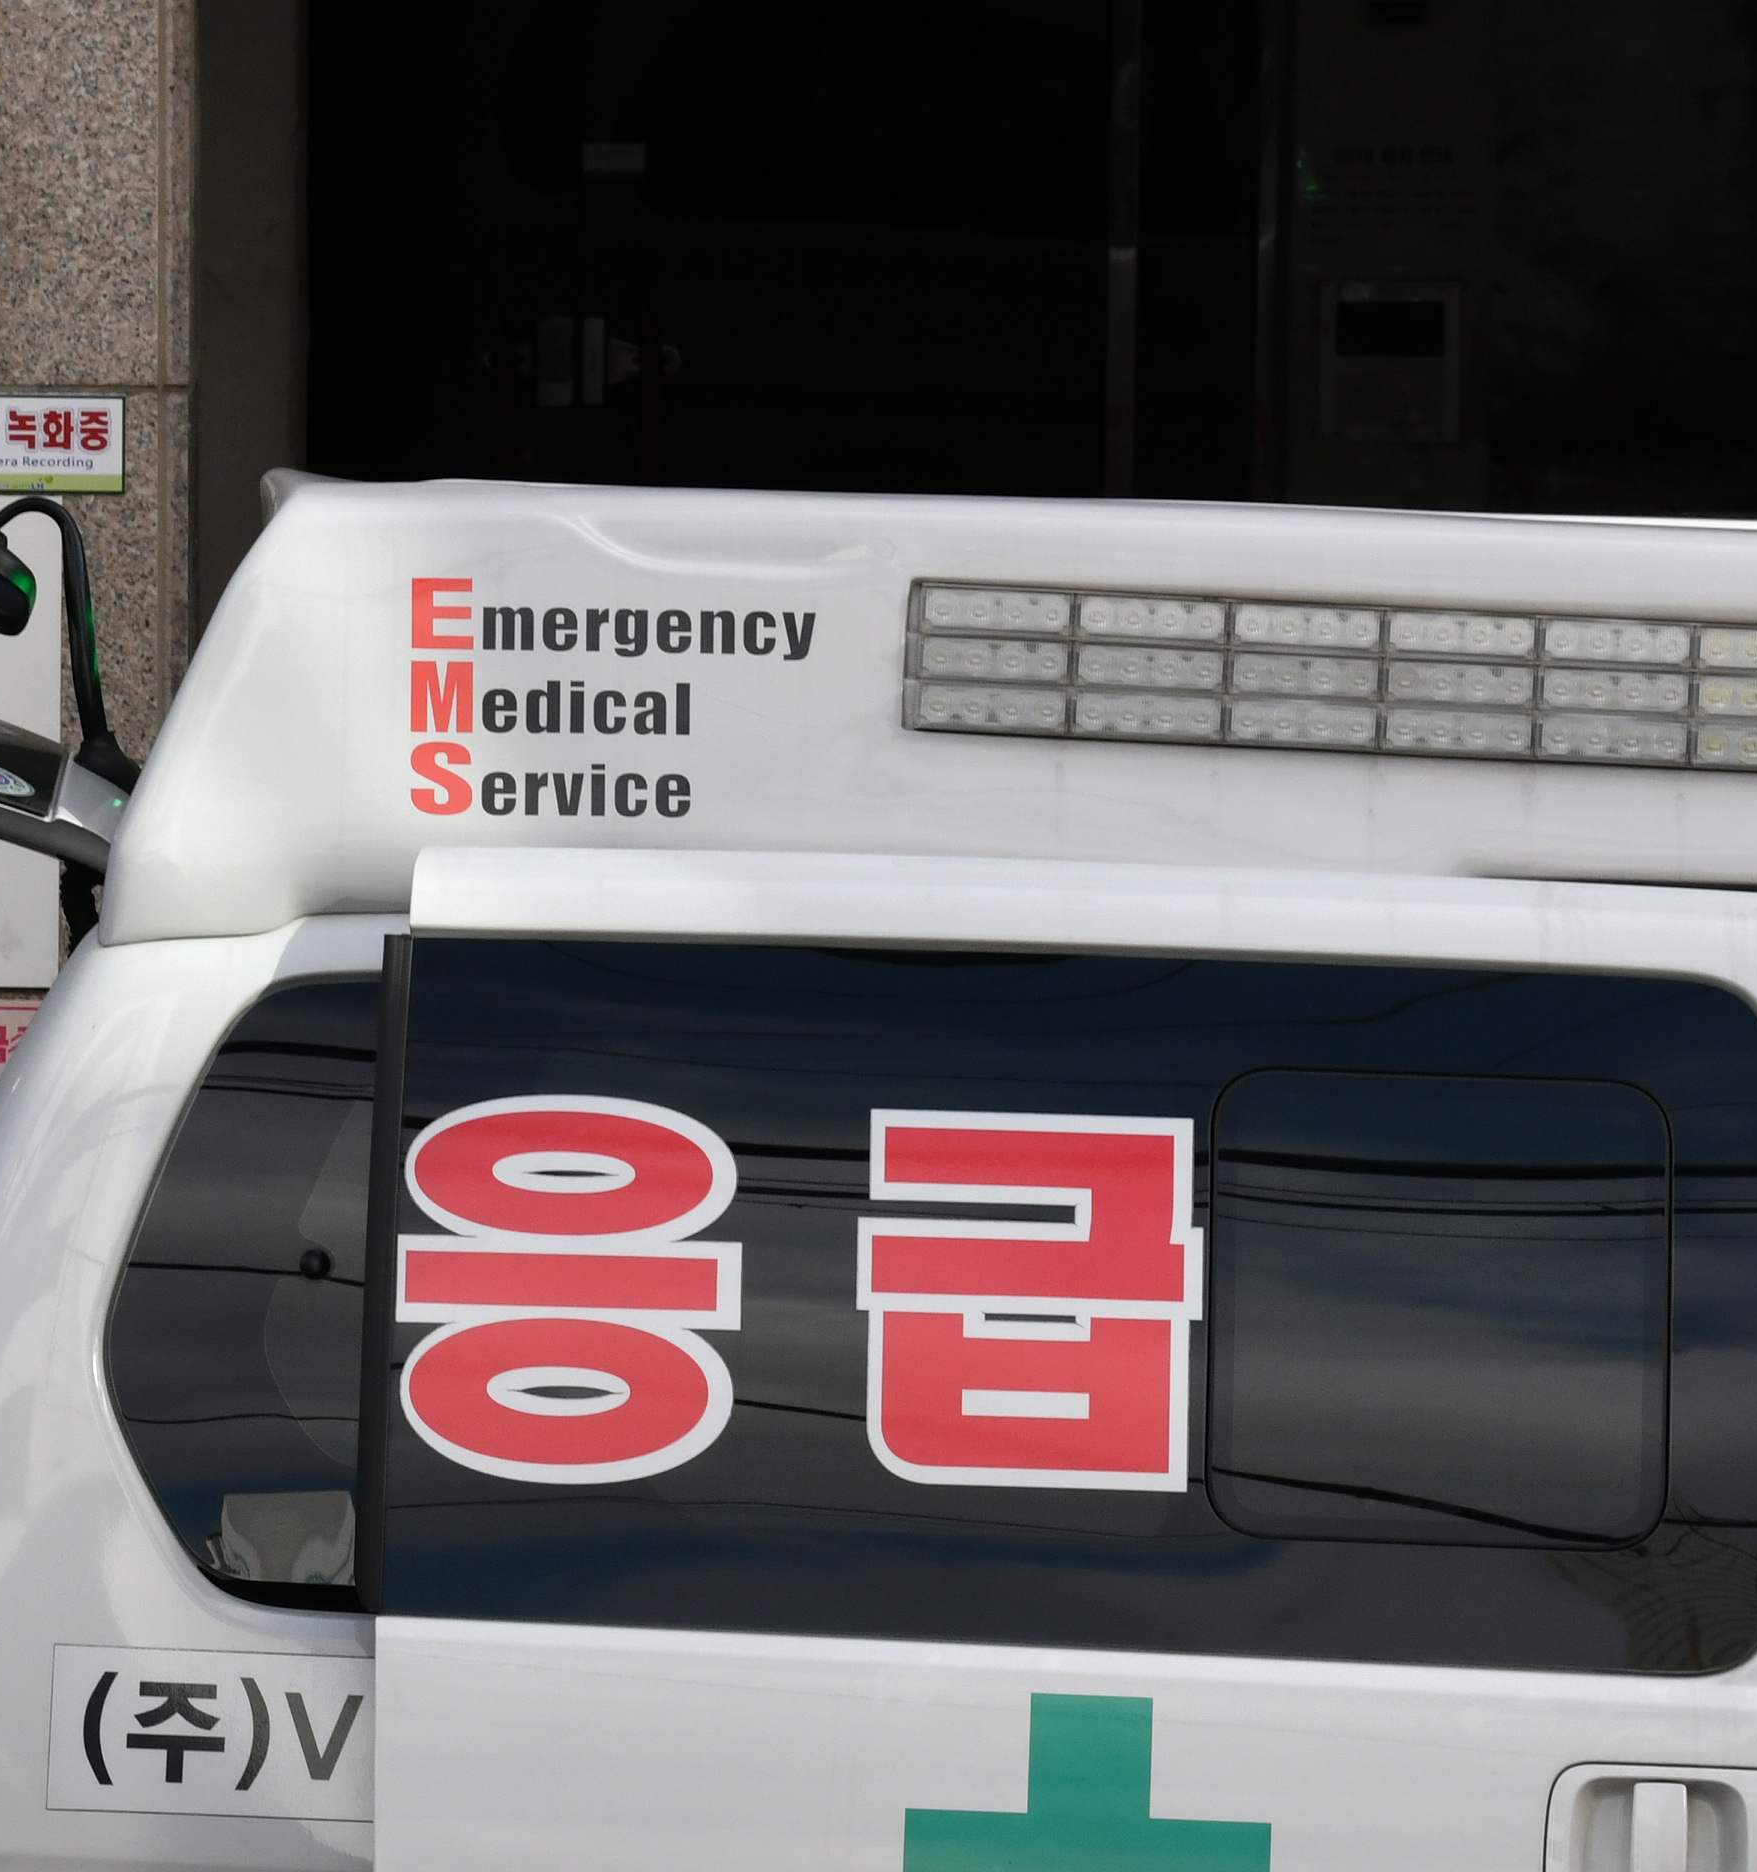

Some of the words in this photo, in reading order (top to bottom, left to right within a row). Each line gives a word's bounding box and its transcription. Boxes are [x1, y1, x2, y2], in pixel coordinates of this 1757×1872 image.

[7, 410, 109, 451] 녹화중
[22, 456, 94, 471] Recording
[410, 577, 817, 661] Emergency
[409, 660, 691, 736] Medical
[409, 741, 692, 818] Service
[396, 1094, 1204, 1493] 응급
